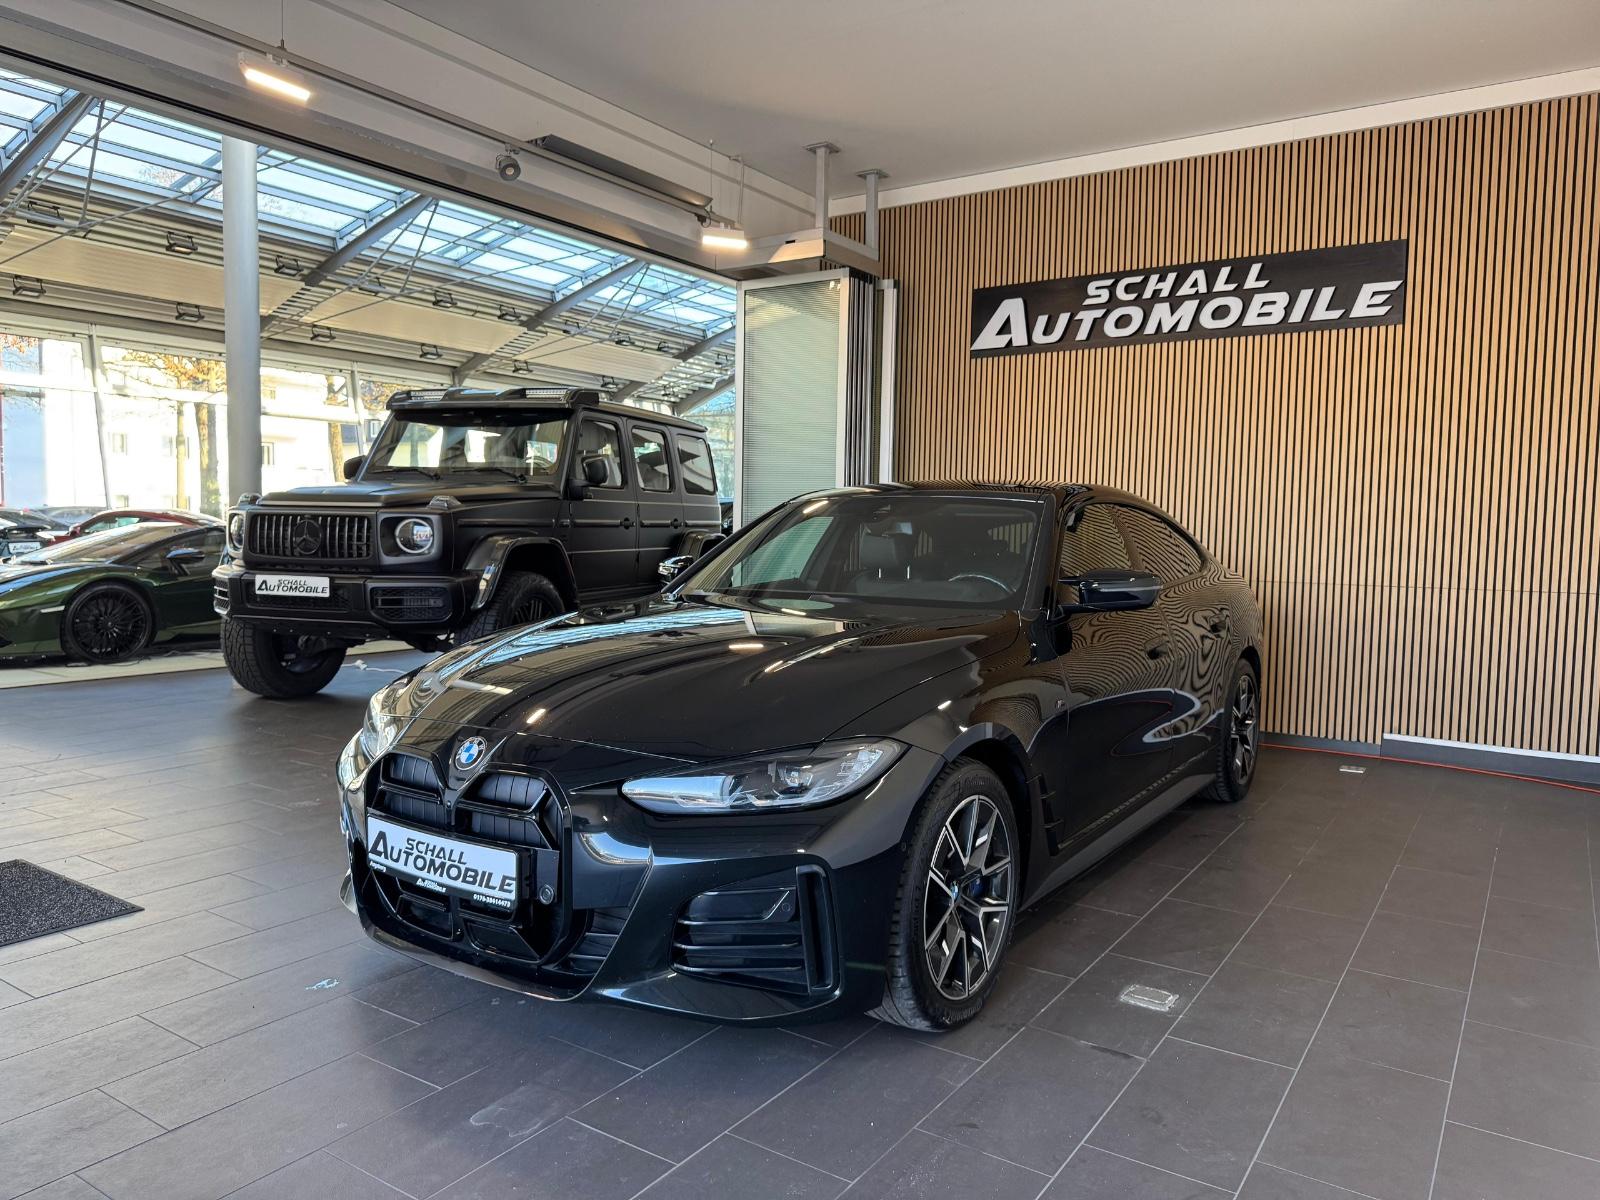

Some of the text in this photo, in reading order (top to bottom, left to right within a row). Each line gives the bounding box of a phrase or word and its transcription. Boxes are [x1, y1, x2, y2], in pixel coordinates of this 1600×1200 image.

[1083, 262, 1271, 306] SCHALL
[970, 280, 1404, 351] AUTOMOBILE
[257, 580, 329, 594] AUTOMOBILE
[368, 830, 517, 894] AUTOMOBILE
[405, 837, 468, 866] SCHALL
